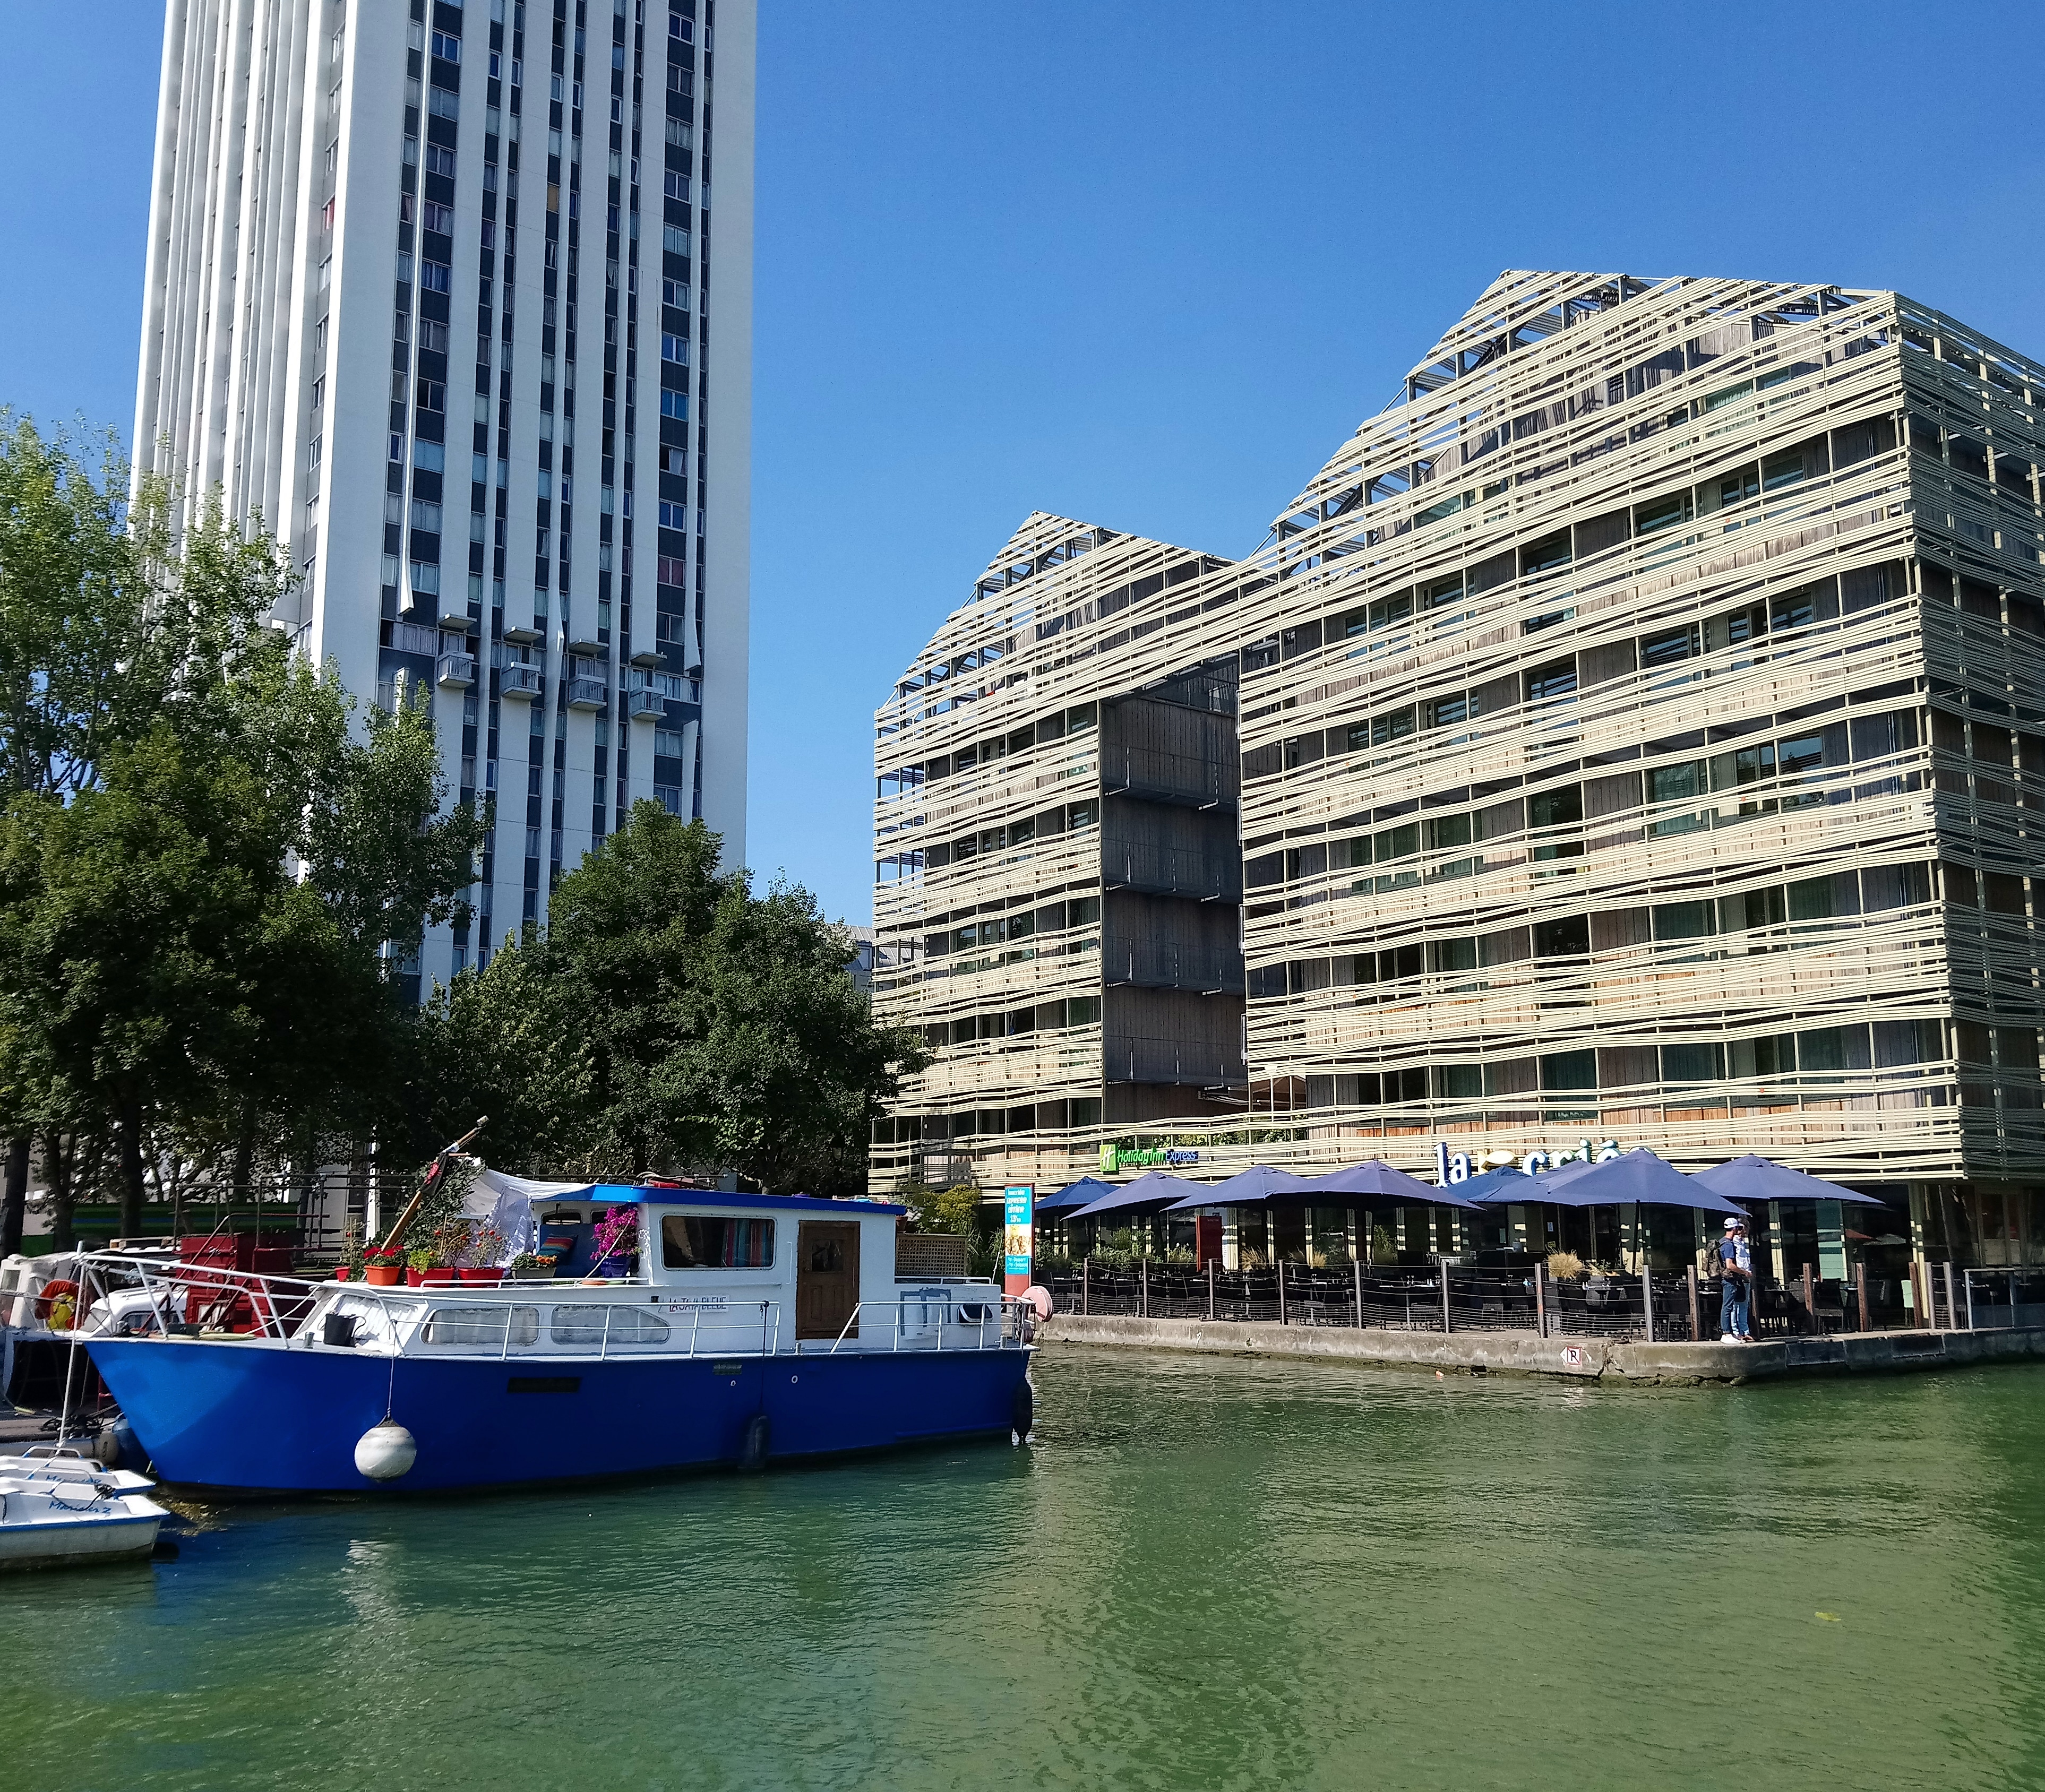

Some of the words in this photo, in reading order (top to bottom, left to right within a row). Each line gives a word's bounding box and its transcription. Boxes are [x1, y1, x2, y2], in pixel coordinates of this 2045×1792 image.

[1117, 1148, 1149, 1165] Holiday
[1149, 1148, 1164, 1162] Inn
[1165, 1150, 1198, 1164] Express
[1433, 1141, 1472, 1188] la
